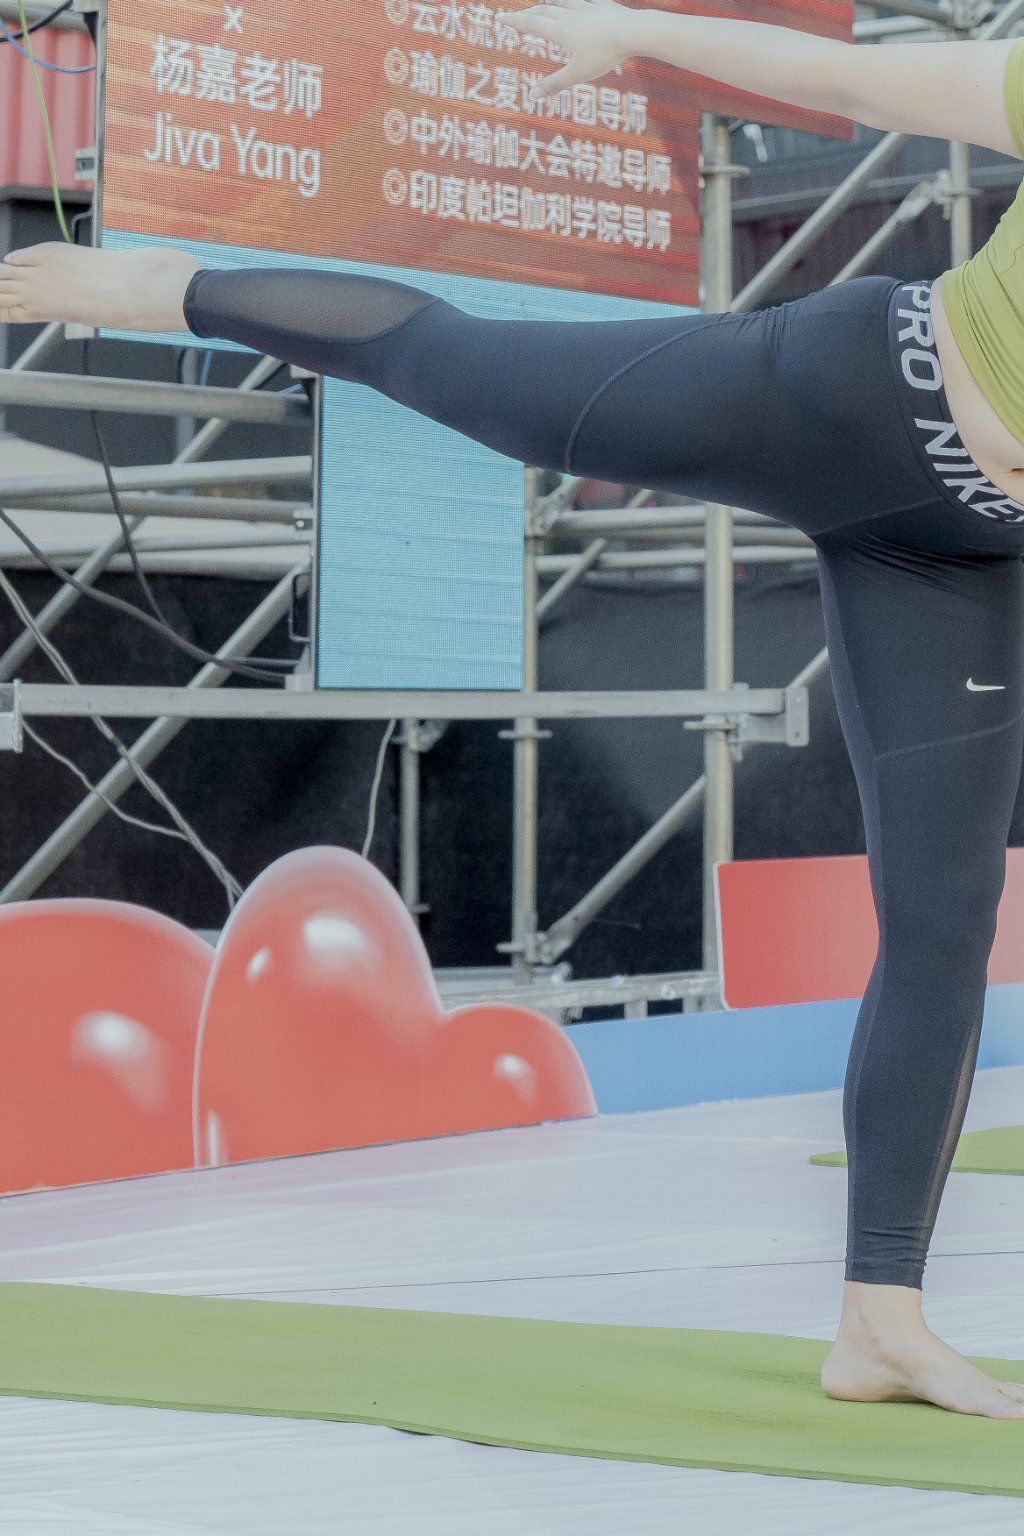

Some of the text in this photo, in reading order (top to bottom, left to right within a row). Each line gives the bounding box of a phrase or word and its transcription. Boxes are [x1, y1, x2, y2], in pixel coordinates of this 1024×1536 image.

[151, 32, 325, 121] 杨嘉老师
[144, 111, 322, 200] Jiva Yang
[409, 109, 672, 197] 中外瑜伽大会特邀导师
[897, 285, 943, 392] PRO
